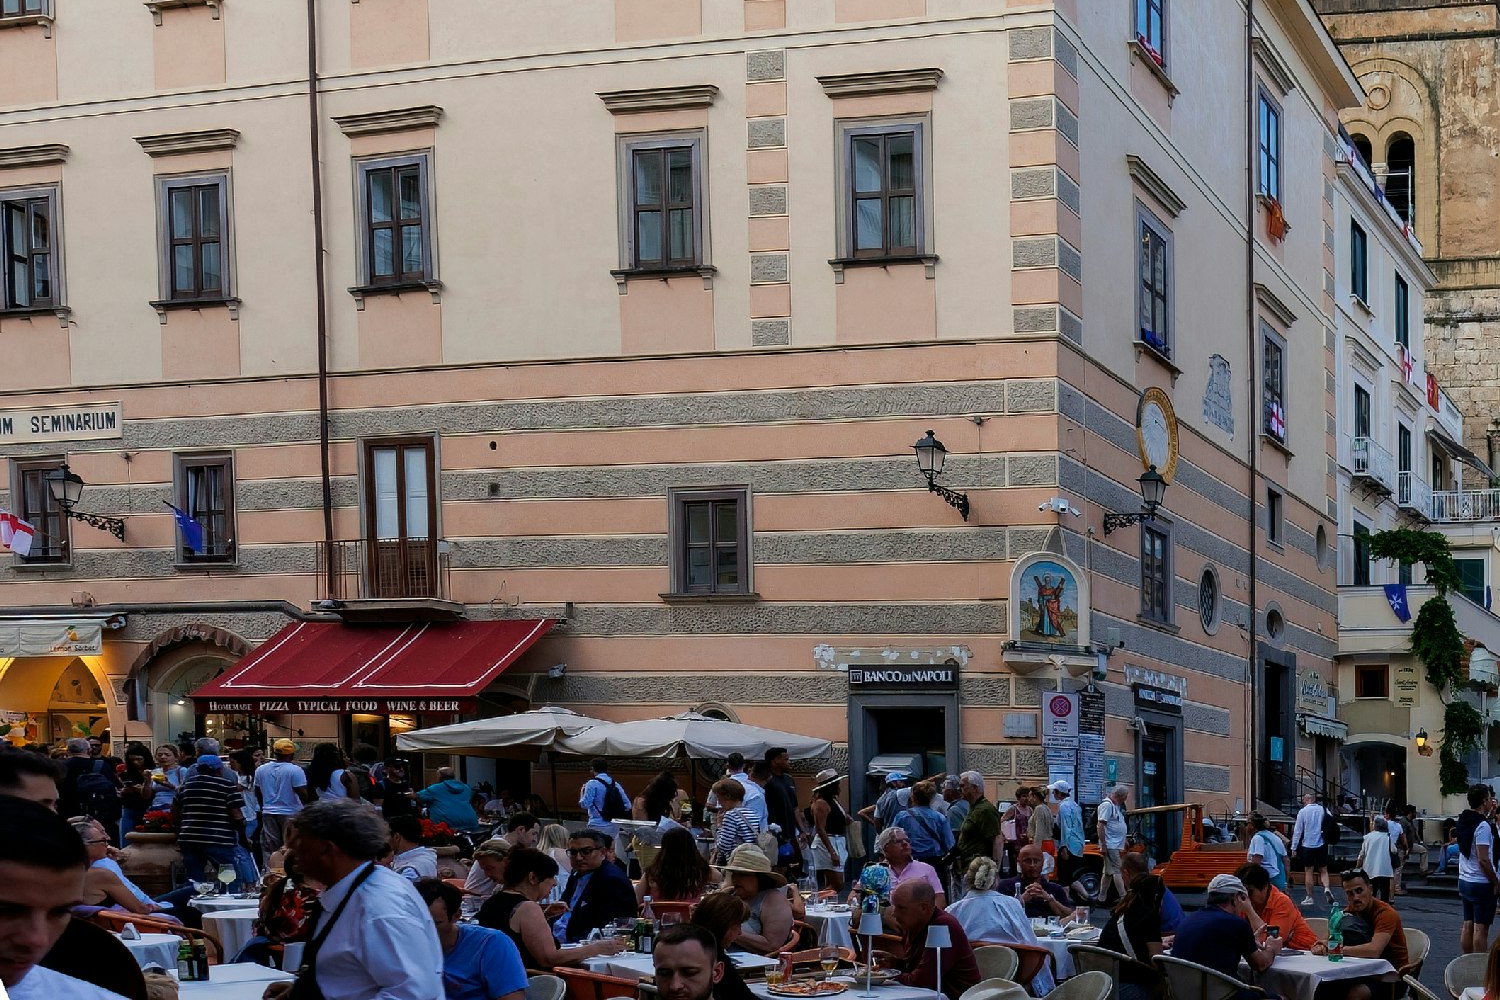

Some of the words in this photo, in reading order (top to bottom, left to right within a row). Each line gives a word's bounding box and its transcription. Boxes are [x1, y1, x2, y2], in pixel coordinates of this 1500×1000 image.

[0, 418, 13, 434] M
[31, 412, 116, 433] SEMINARIUM
[864, 670, 902, 682] BANCO
[912, 670, 953, 682] NAPOLI
[259, 701, 290, 711] PIZZA
[297, 701, 341, 711] TYPICAL
[345, 701, 378, 711] FOOD
[386, 701, 417, 711] WINE
[418, 701, 427, 710] &
[429, 701, 460, 711] BEER
